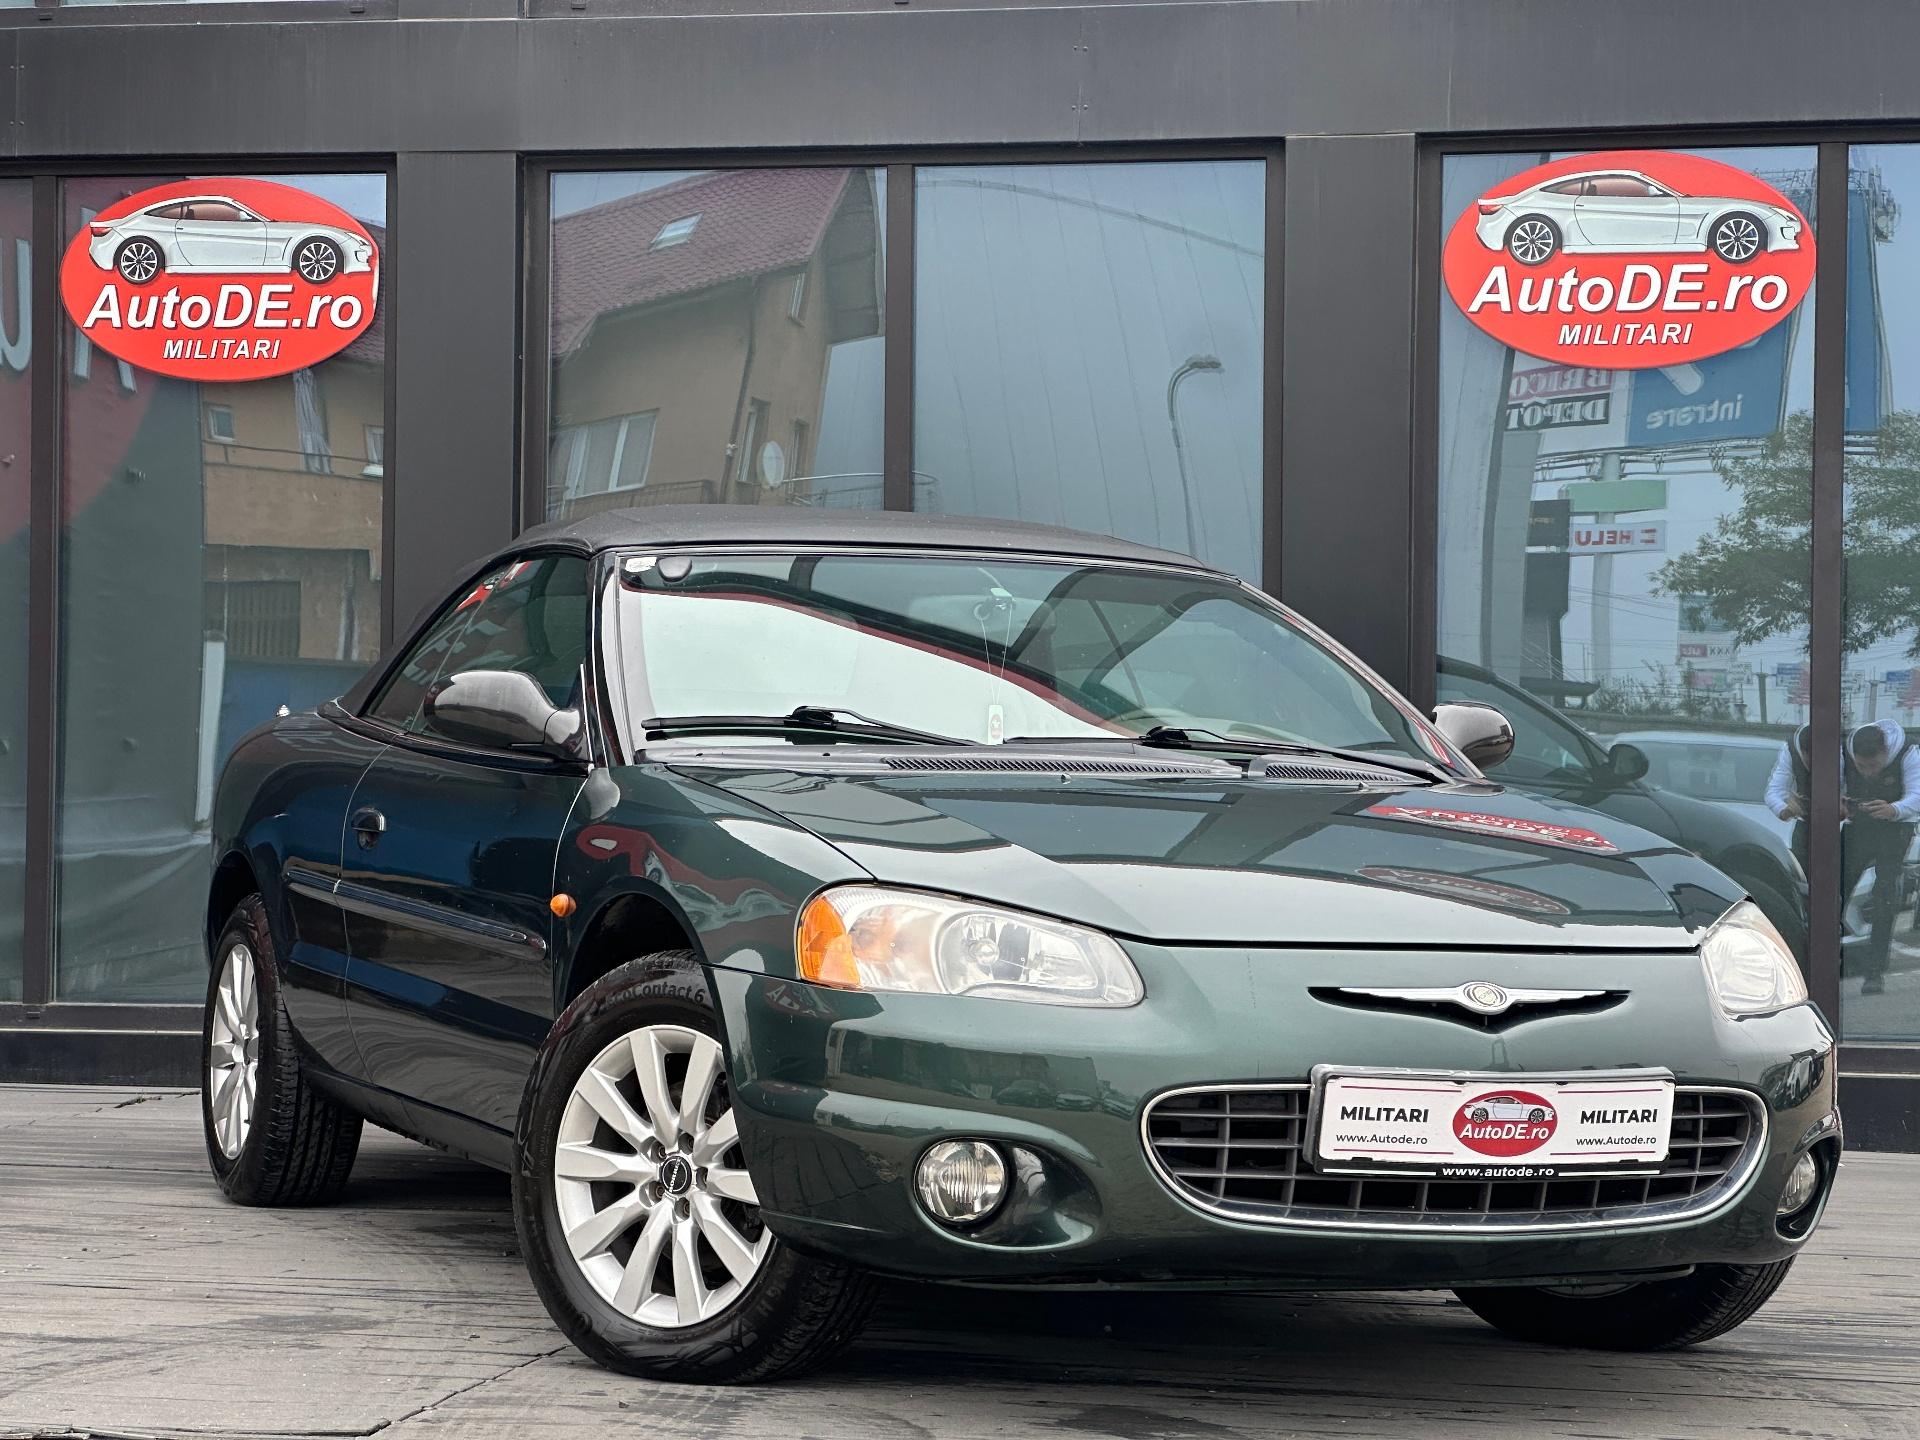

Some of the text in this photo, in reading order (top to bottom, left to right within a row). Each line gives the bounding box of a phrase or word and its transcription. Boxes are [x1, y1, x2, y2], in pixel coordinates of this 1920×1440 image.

[1467, 263, 1789, 313] AutoDE.ro
[82, 284, 363, 329] AutoDE.ro
[1558, 322, 1694, 346] MILITARI
[163, 338, 281, 360] MILITARI
[1340, 1106, 1430, 1123] MILITARI
[1580, 1109, 1658, 1124] MILITARI
[1336, 1134, 1428, 1145] www.Autode.ro
[1459, 1124, 1549, 1140] AutoDE.ro
[1576, 1136, 1657, 1146] www.Autode.ro
[1442, 1167, 1554, 1177] www.autode.ro
